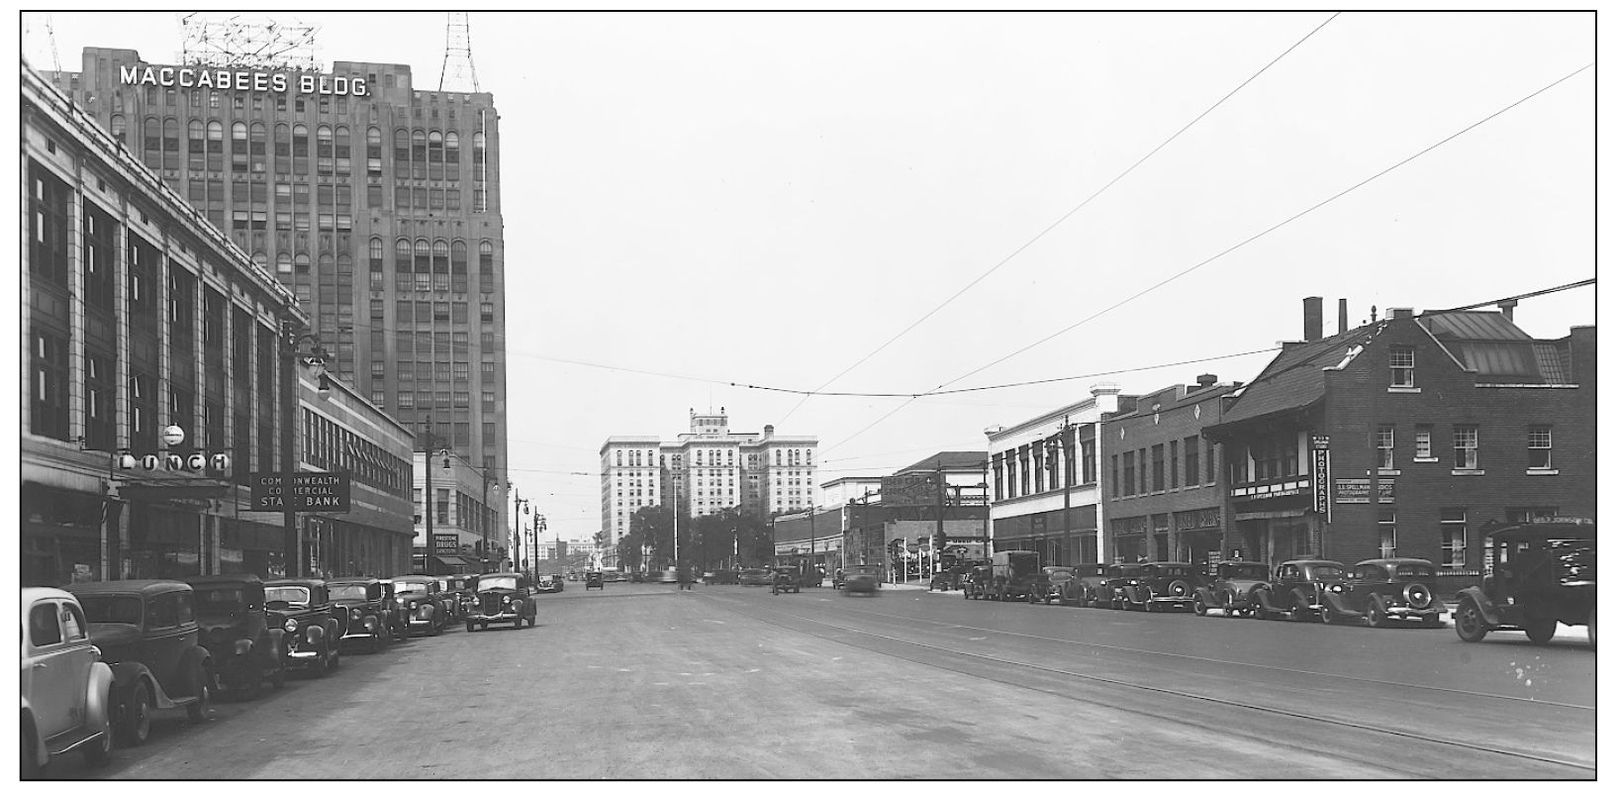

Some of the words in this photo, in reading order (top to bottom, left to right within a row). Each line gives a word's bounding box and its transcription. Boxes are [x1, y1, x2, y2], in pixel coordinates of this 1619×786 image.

[120, 65, 288, 93] MACCABEES
[300, 74, 372, 97] BLDG.
[118, 455, 226, 471] LUNCH
[260, 476, 340, 486] COMNWEALTH
[1317, 449, 1326, 513] PHOTOGRAPHS
[268, 487, 333, 496] COERCIAL
[260, 497, 297, 507] STA
[306, 497, 340, 506] BANK
